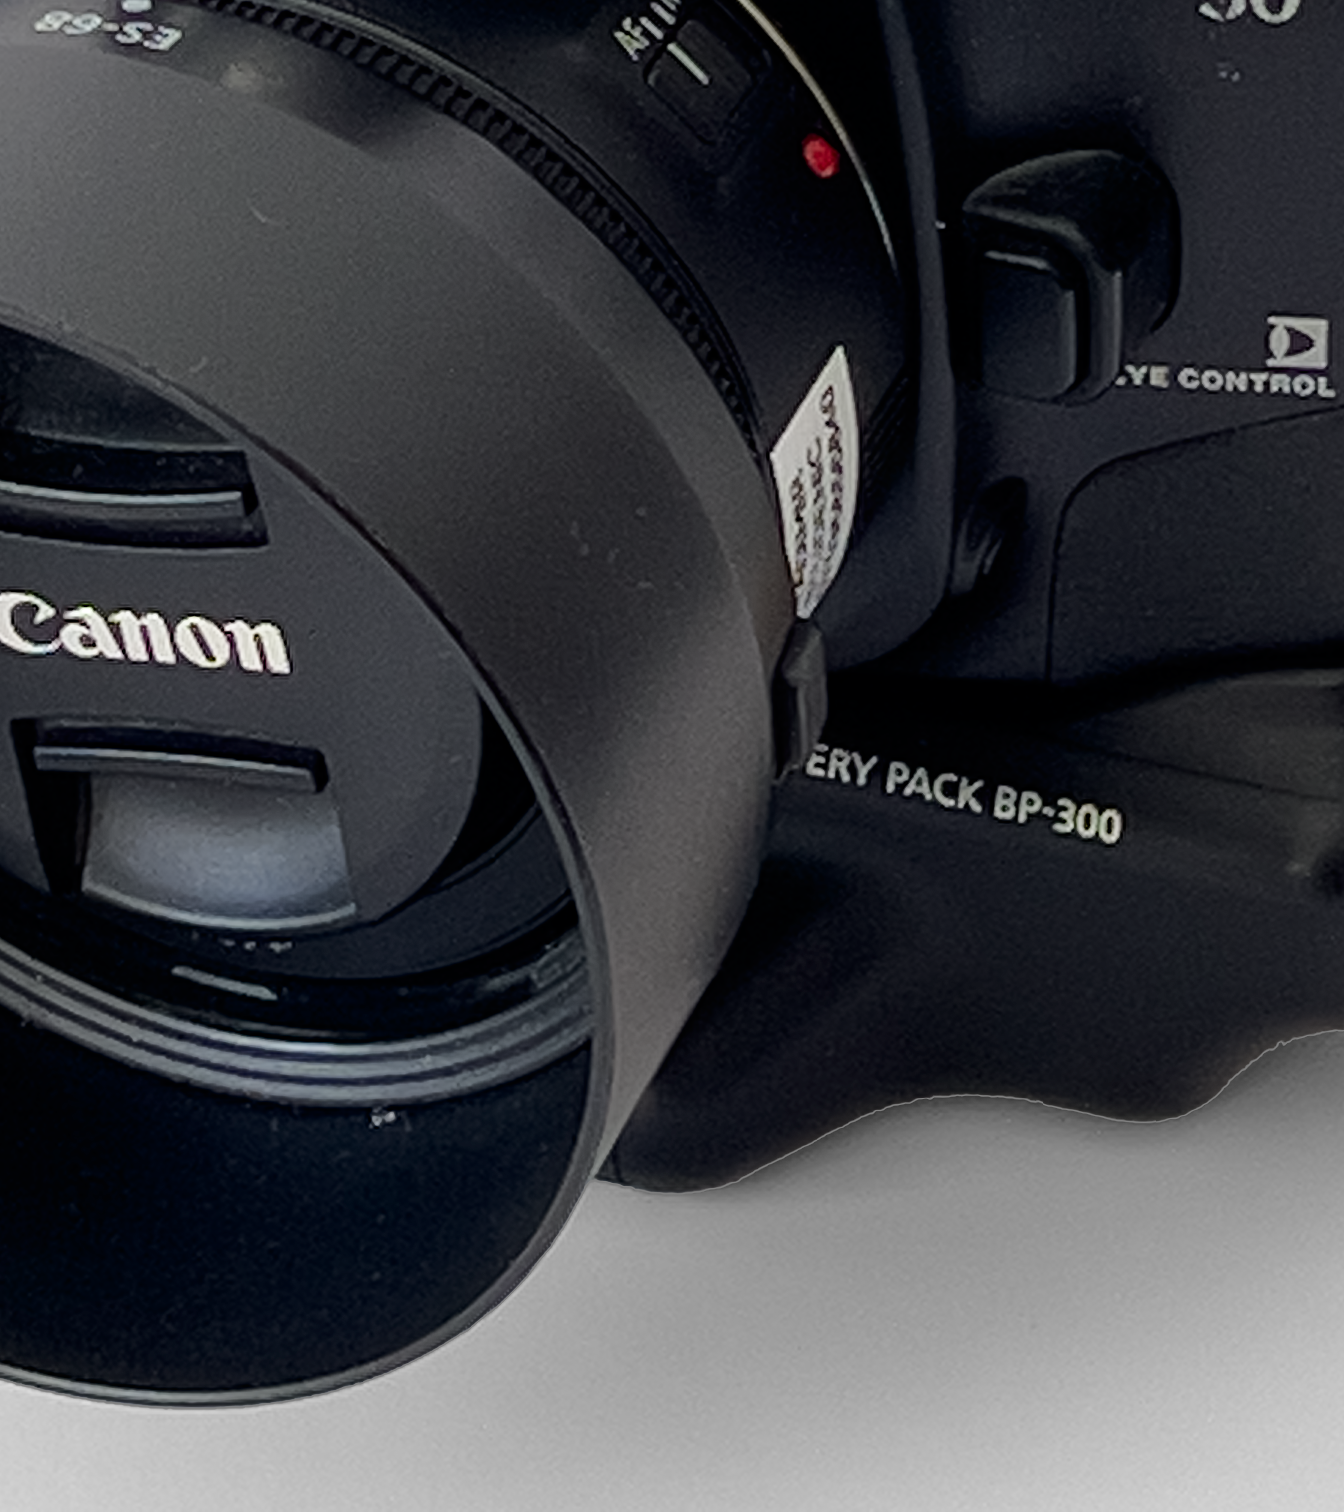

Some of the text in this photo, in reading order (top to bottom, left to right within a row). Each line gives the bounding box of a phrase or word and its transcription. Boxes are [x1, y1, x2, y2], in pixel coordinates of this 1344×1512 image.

[613, 16, 650, 61] AF
[1114, 364, 1337, 399] YE CONTROL
[885, 760, 985, 815] PACK
[992, 783, 1124, 846] BP-300
